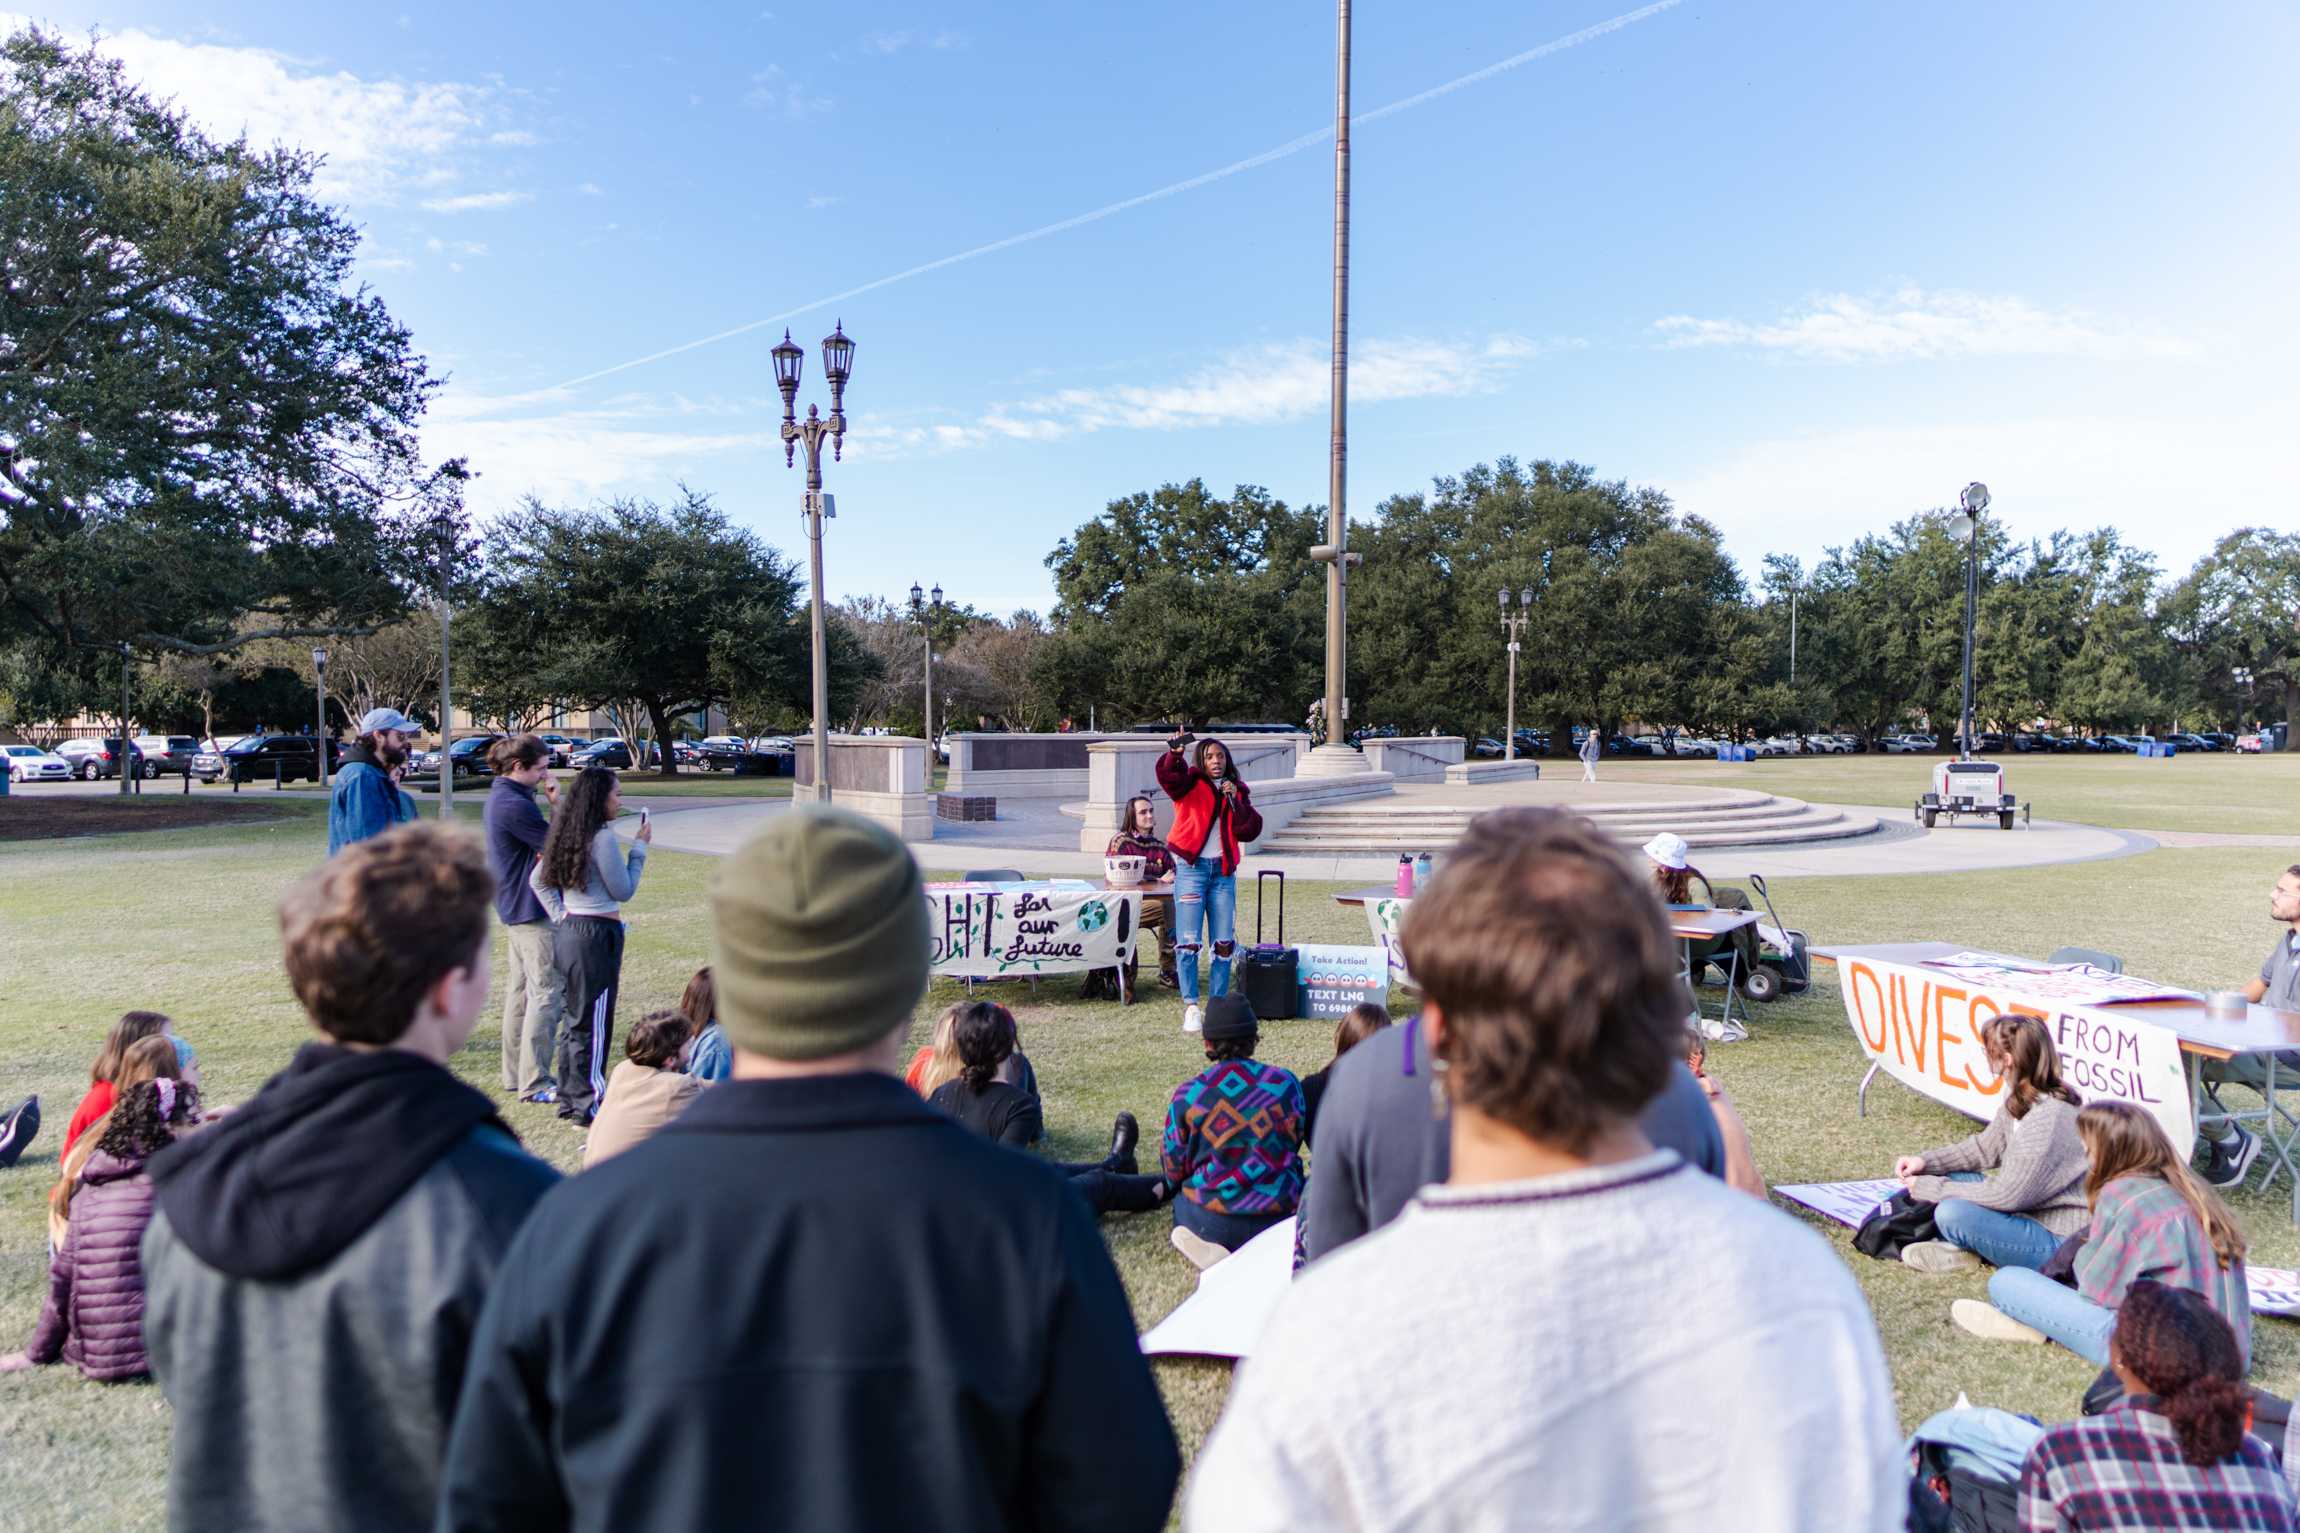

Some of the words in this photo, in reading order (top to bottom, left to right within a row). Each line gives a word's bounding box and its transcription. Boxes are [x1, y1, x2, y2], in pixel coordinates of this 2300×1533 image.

[1014, 893, 1052, 917] for
[1005, 935, 1083, 961] future
[1312, 955, 1333, 964] Take
[1336, 956, 1367, 965] Action!
[1308, 990, 1337, 1000] TEXT
[1341, 991, 1364, 1001] LNG
[1313, 1003, 1325, 1012] TO
[2058, 1013, 2139, 1066] FROM
[2057, 1052, 2162, 1103] FOSSIL
